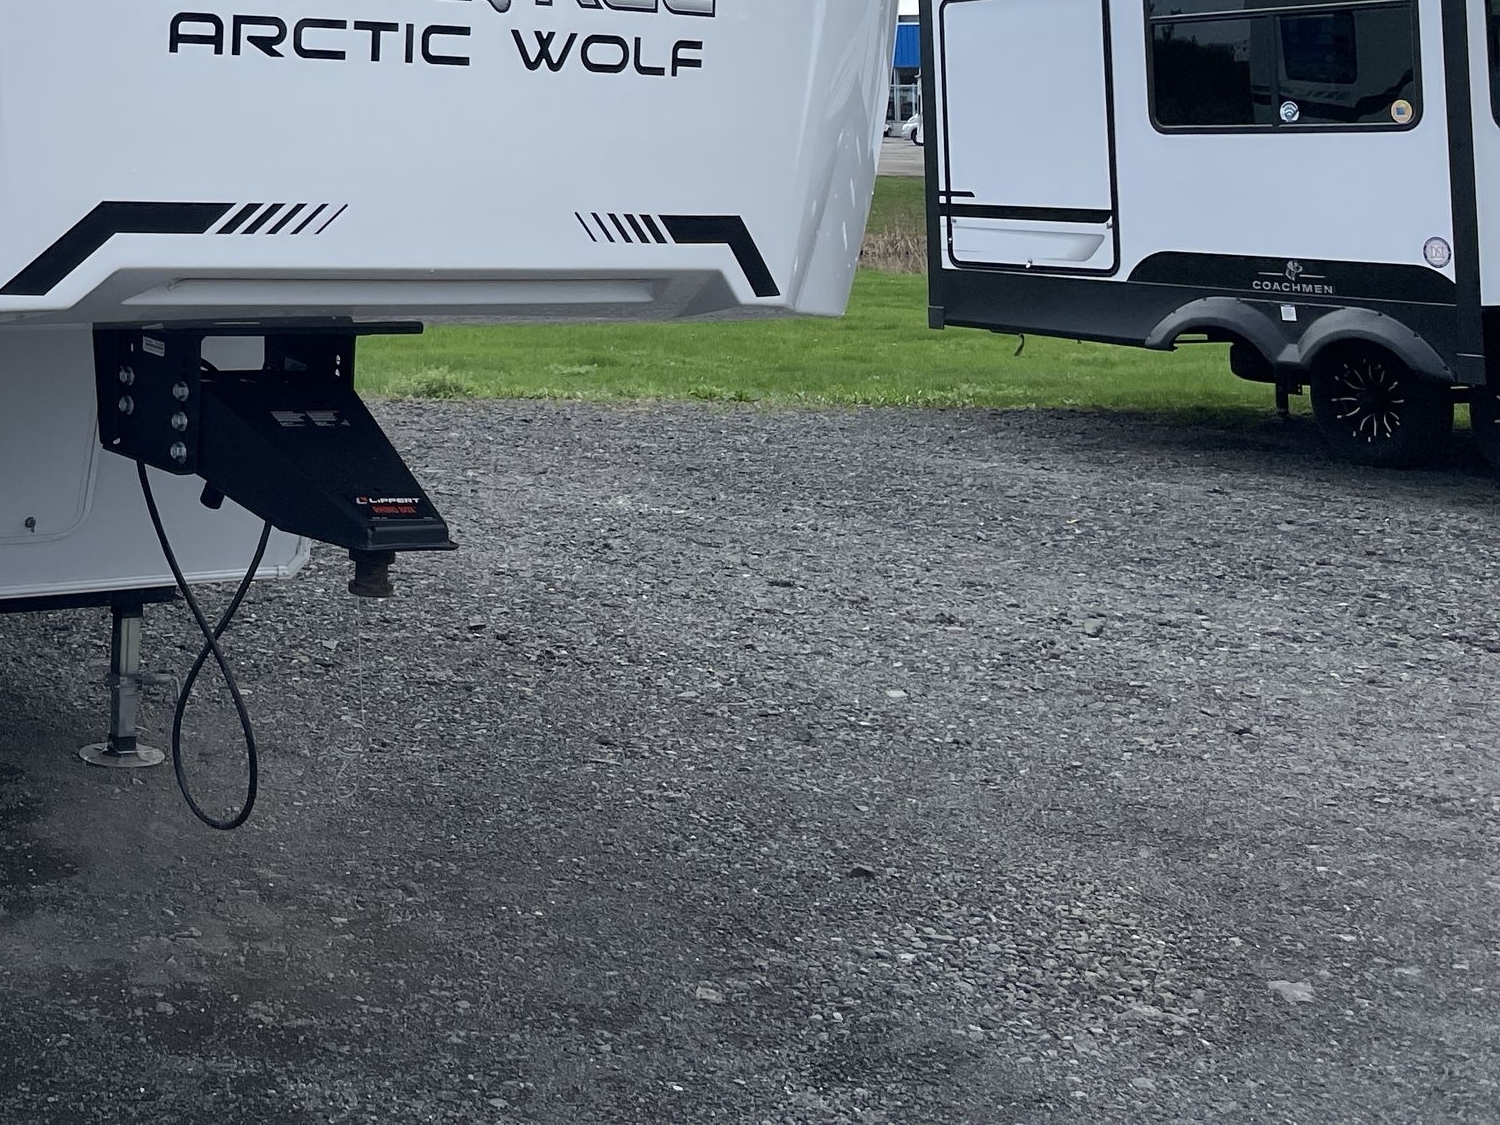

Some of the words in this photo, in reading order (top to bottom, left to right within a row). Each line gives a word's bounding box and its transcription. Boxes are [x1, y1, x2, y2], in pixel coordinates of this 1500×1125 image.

[169, 11, 471, 66] ARCTIC
[510, 28, 704, 77] WOLF
[1252, 280, 1334, 294] COACHMEN
